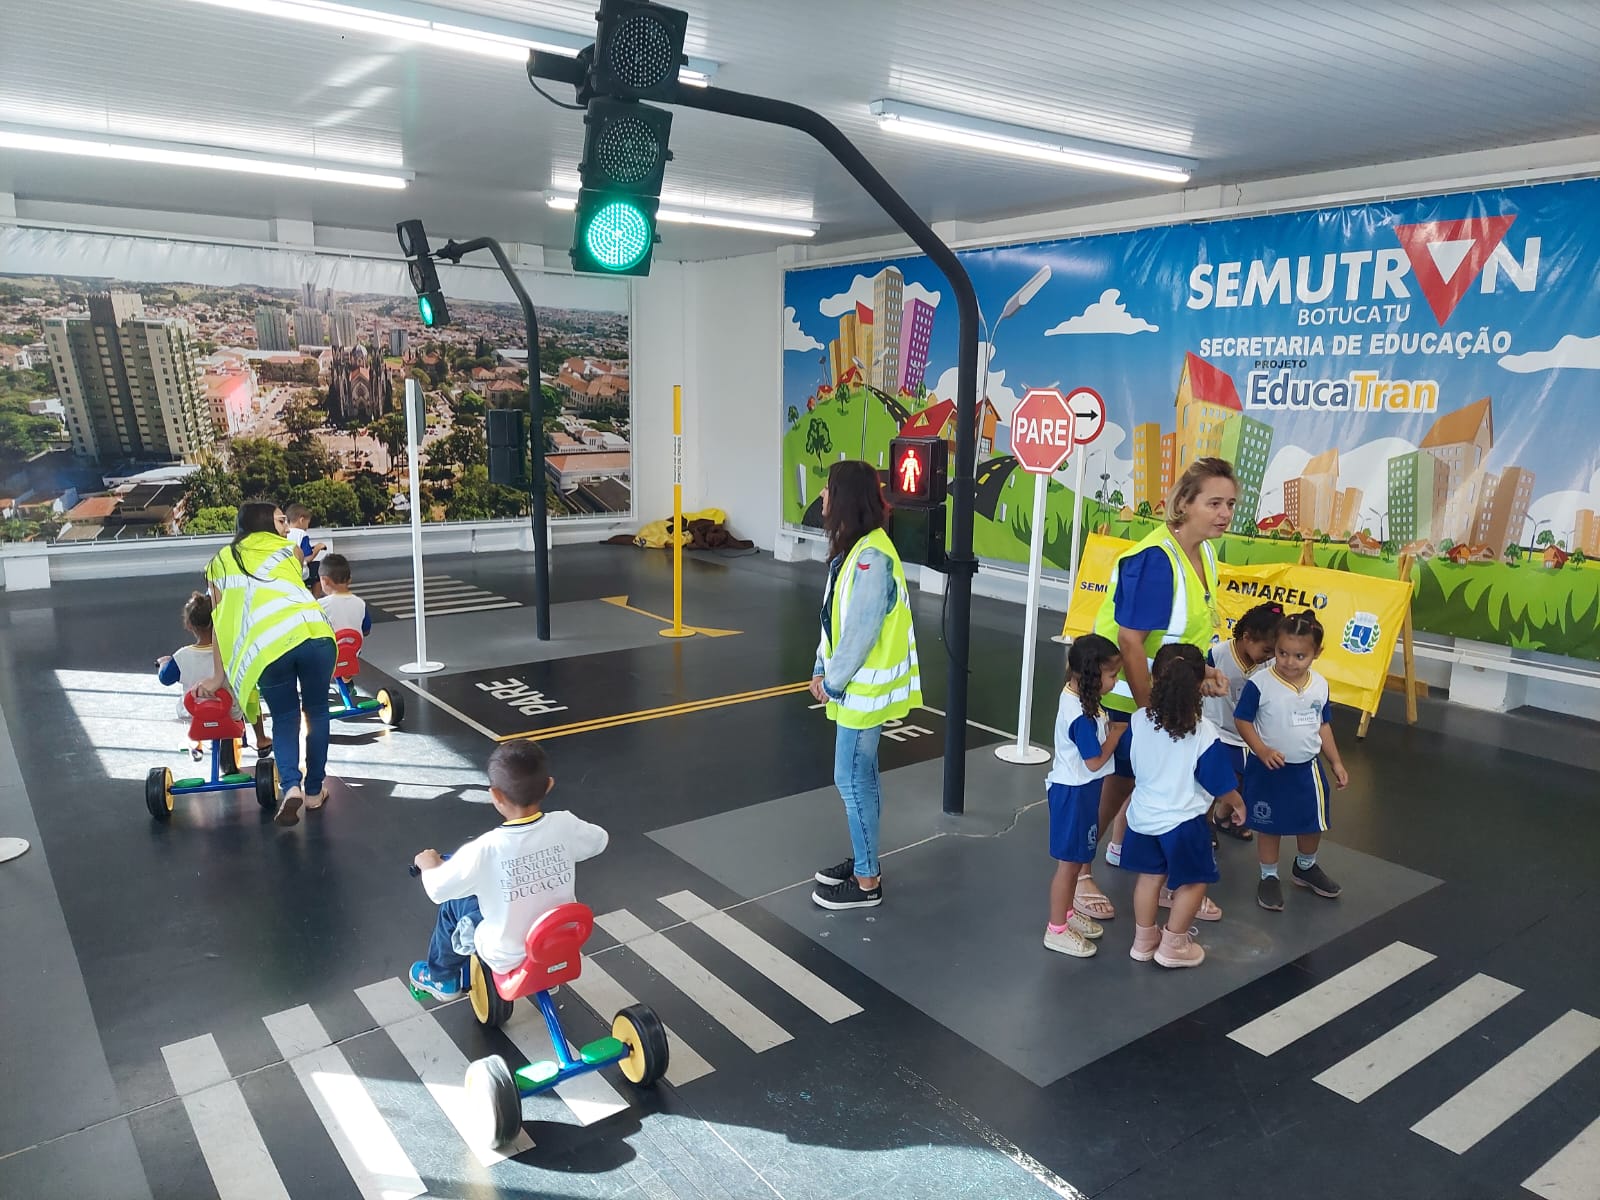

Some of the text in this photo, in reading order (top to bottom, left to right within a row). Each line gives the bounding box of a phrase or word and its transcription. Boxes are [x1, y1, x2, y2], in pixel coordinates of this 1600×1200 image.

[1298, 304, 1411, 326] BOTUCATU
[1200, 326, 1512, 360] SECRETARIA DE EDUCAÇÃO
[1254, 359, 1308, 370] PROJETO
[1249, 371, 1437, 411] EducaTran
[1016, 417, 1068, 447] PARE
[1226, 580, 1328, 609] AMARELO
[475, 677, 569, 716] PARE
